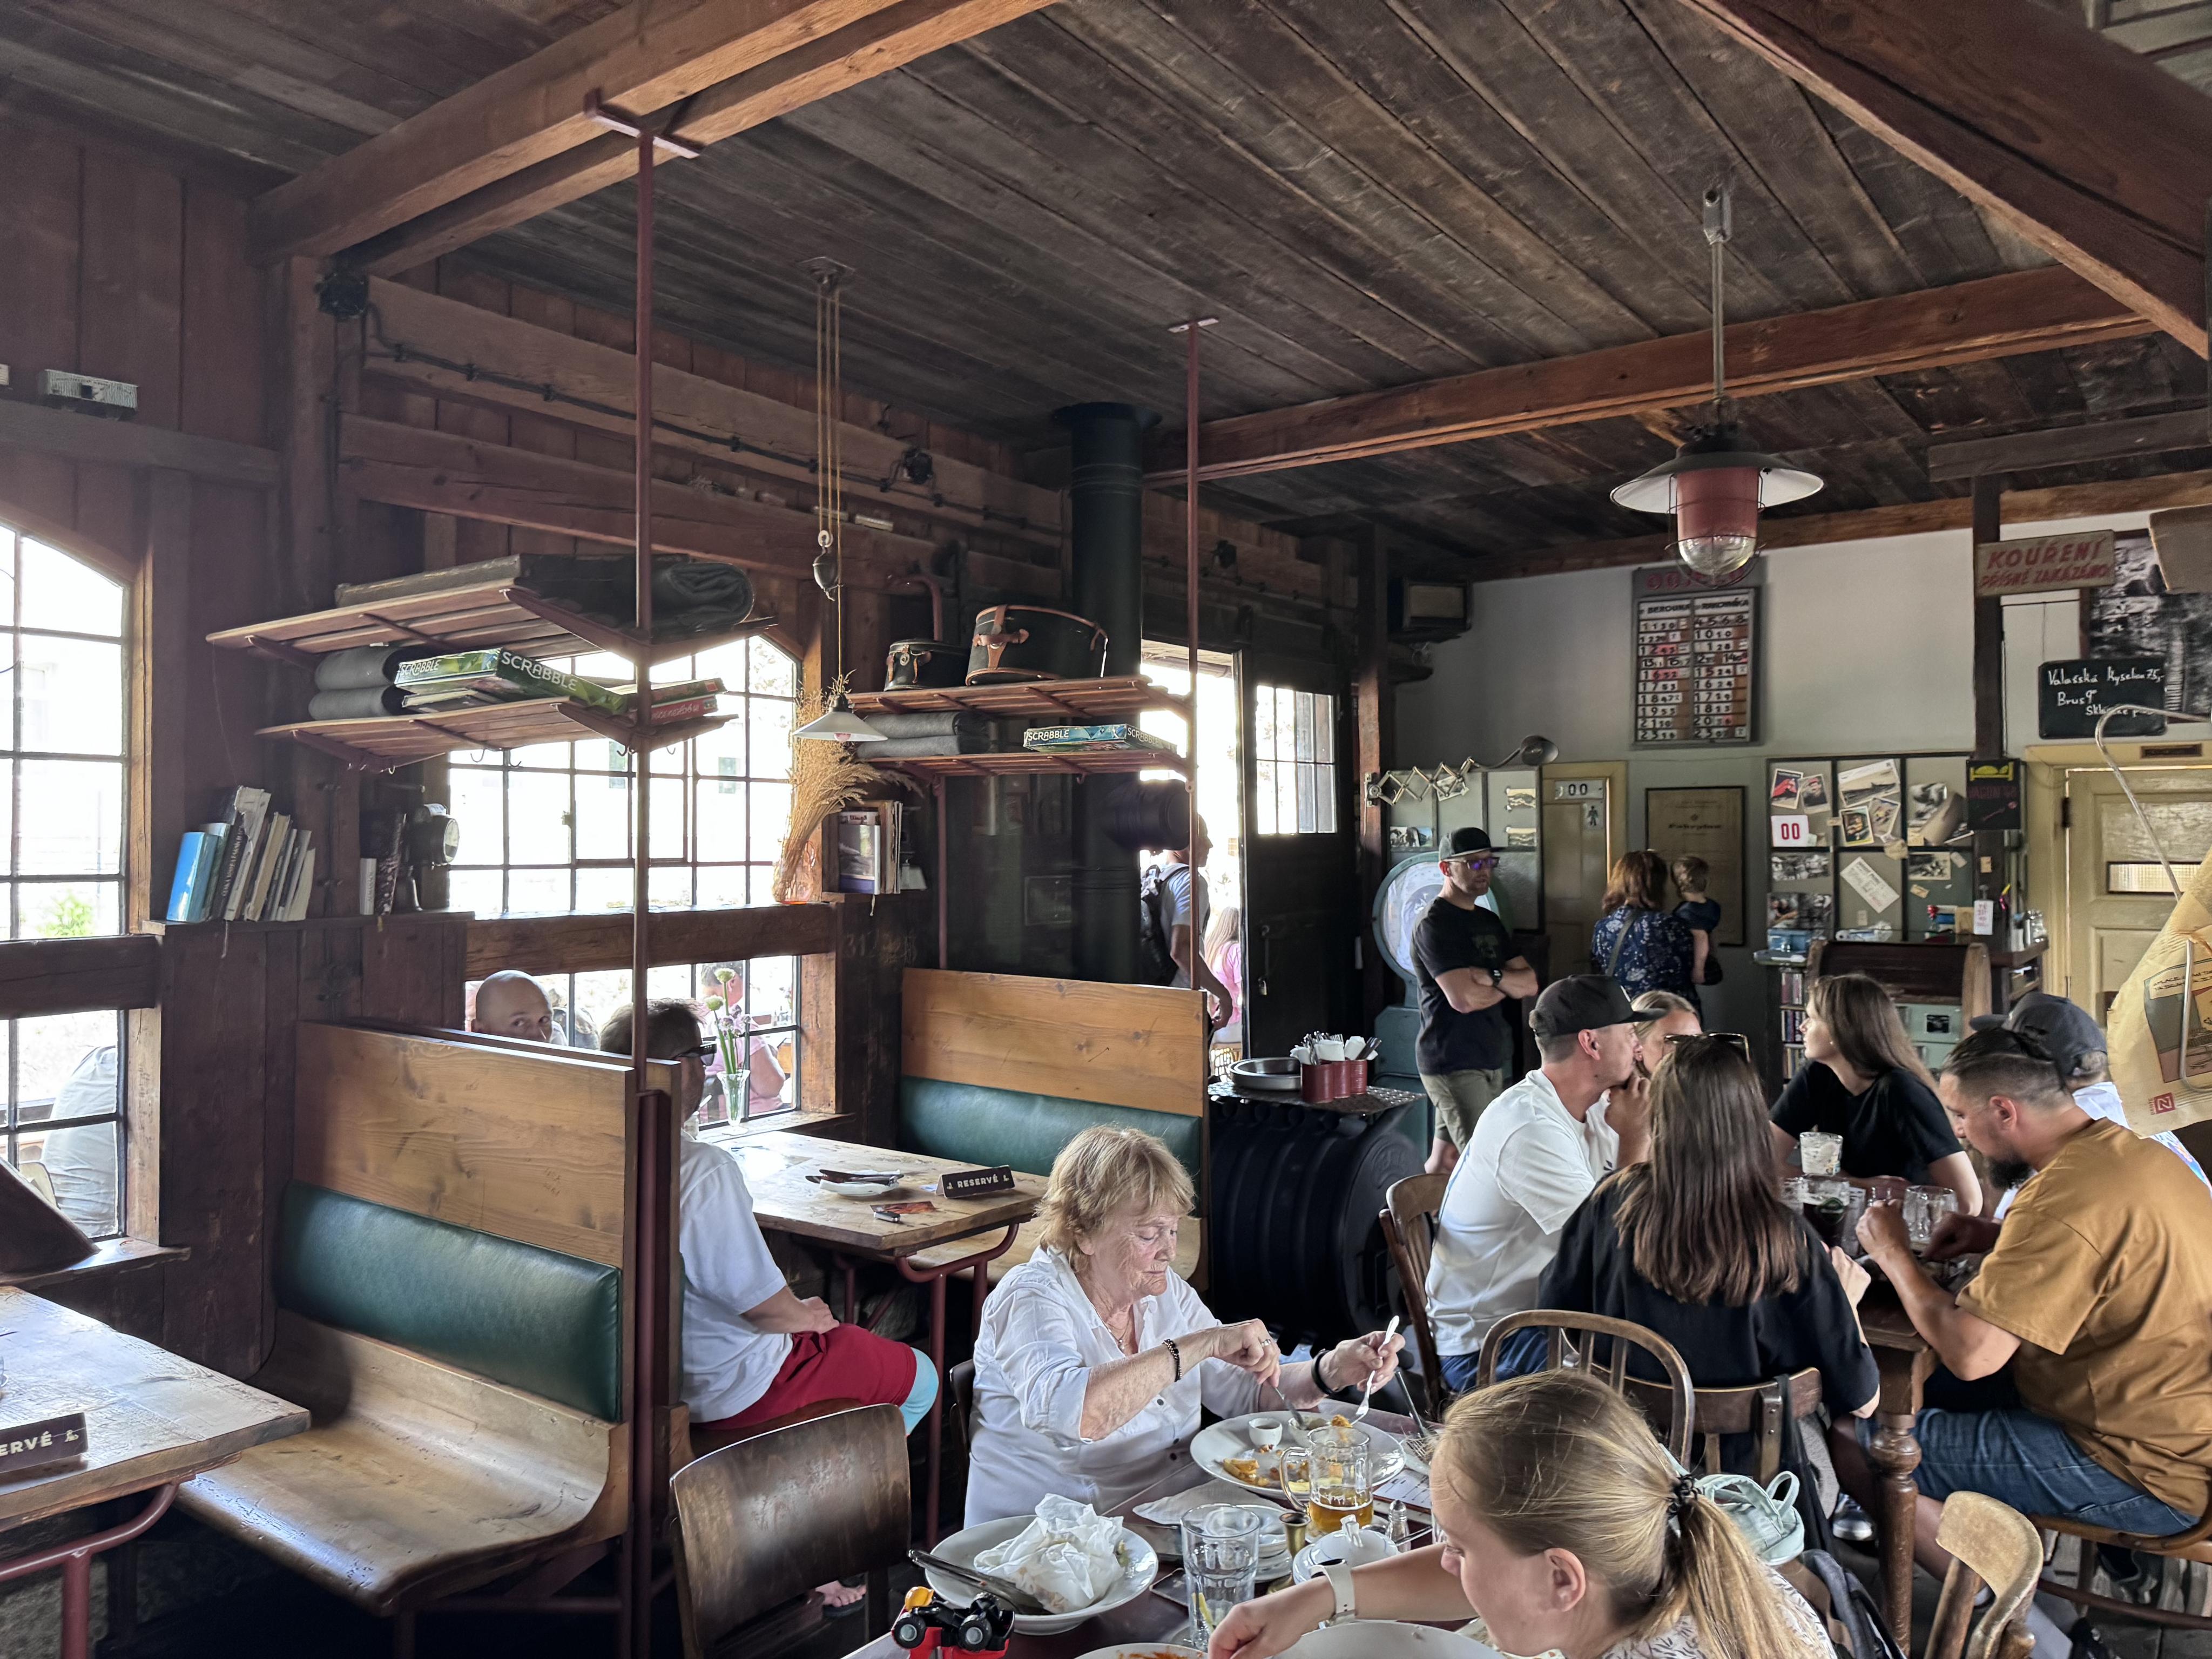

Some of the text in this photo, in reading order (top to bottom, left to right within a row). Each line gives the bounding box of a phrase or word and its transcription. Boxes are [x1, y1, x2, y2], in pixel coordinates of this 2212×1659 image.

[1987, 537, 2106, 570] KOUŘENÍ
[401, 659, 442, 676] SCRABBLE
[501, 651, 580, 692] SCRABBLE
[1028, 729, 1069, 741] SCRABBLE
[1127, 727, 1159, 745] SCRABBLE
[1568, 783, 1588, 796] 00
[1781, 823, 1800, 840] 00
[957, 1174, 999, 1188] RESERVÉ
